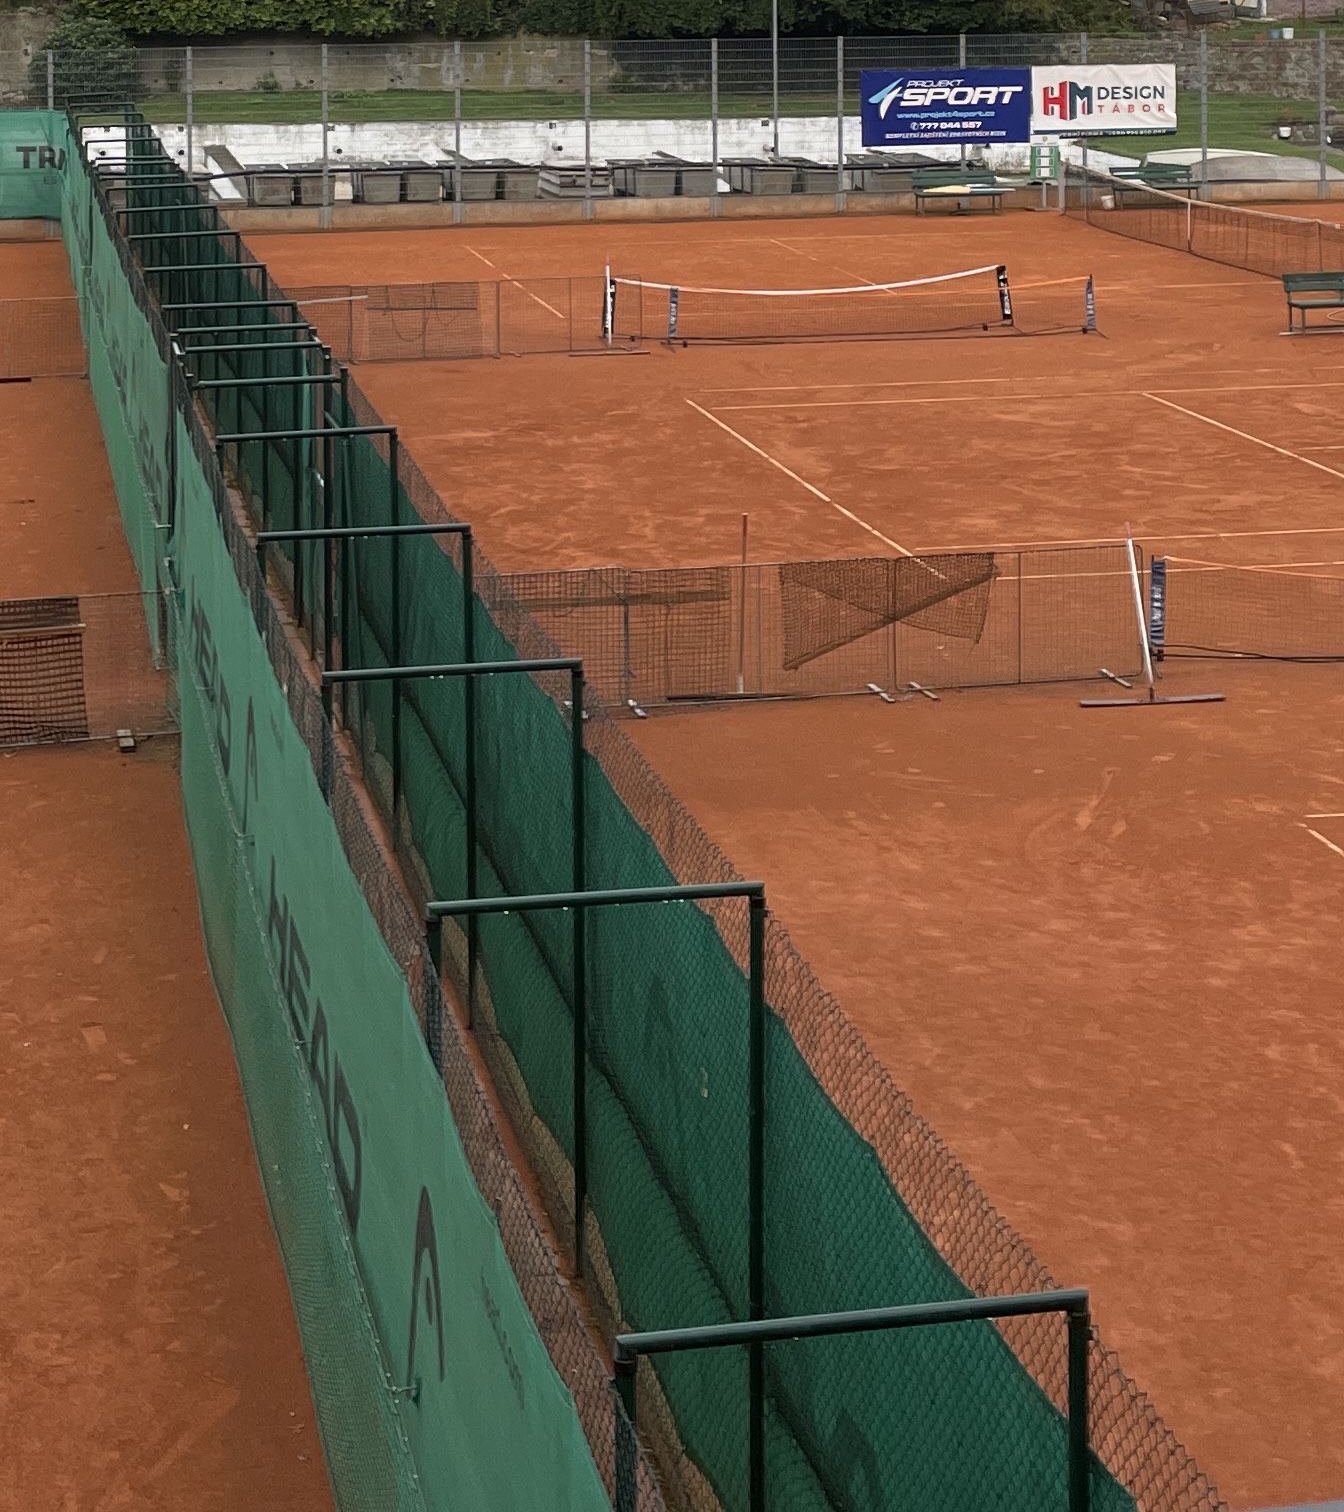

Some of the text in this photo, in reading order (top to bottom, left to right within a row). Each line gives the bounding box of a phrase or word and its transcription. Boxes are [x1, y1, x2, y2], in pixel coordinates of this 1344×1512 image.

[906, 79, 964, 88] PROJEKT
[1043, 80, 1165, 120] HM DESIGN
[1097, 102, 1166, 113] TÁBOR
[190, 574, 232, 778] HEAD
[269, 854, 362, 1238] HEAD
